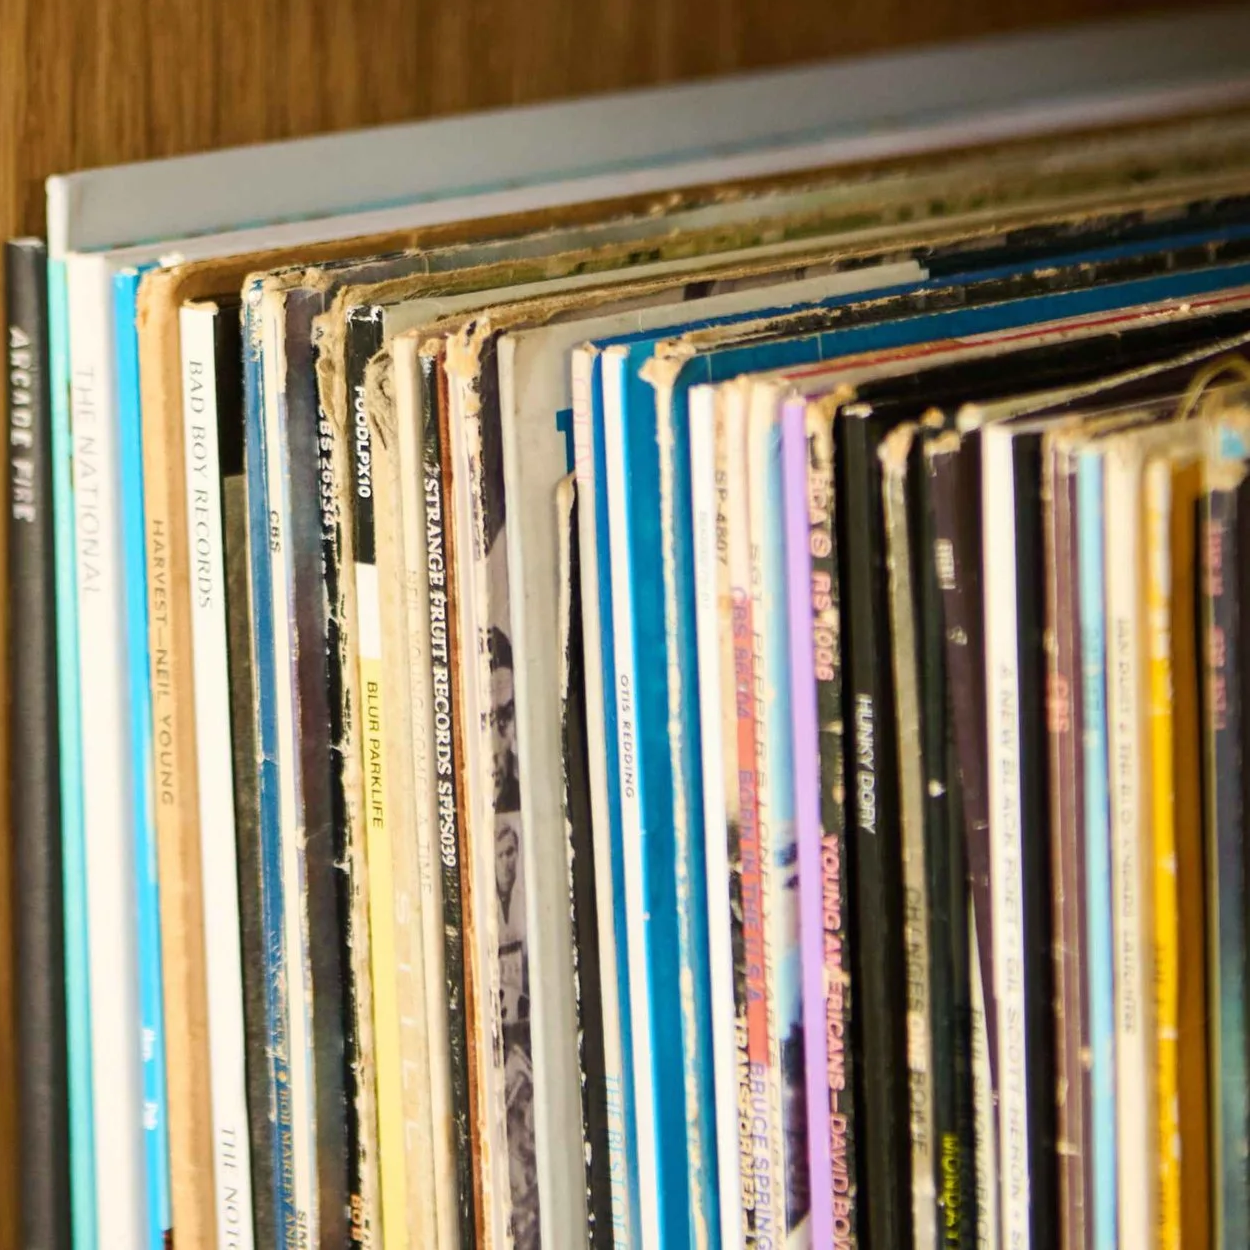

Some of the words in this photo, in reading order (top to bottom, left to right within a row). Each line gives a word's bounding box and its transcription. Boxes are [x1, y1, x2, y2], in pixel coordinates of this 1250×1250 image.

[10, 326, 34, 448] ARCADE
[73, 367, 98, 424] THE
[188, 360, 205, 414] BAD
[191, 426, 209, 482] BOY
[354, 385, 371, 498] FOODLPX10
[12, 458, 37, 522] FIRE
[76, 435, 103, 598] NATIONAL
[321, 458, 336, 527] 26334
[193, 489, 215, 609] RECORDS
[269, 510, 282, 553] CBS
[424, 478, 445, 585] STRANGE
[429, 590, 448, 662] FRUIT
[366, 681, 380, 733] BLUR
[432, 667, 453, 775] RECORDS
[620, 674, 631, 712] OTIS
[158, 714, 174, 806] YOUNG
[621, 721, 635, 799] REDDING
[854, 692, 875, 770] HUNKY
[368, 739, 384, 831] PARKLIFE
[857, 770, 878, 835] DORY
[437, 782, 457, 867] SFPS039
[820, 833, 842, 931] YOUNG
[279, 1089, 292, 1125] BOB
[748, 1062, 769, 1150] BRUCE
[220, 1127, 237, 1170] THE
[281, 1131, 296, 1204] MARLEY
